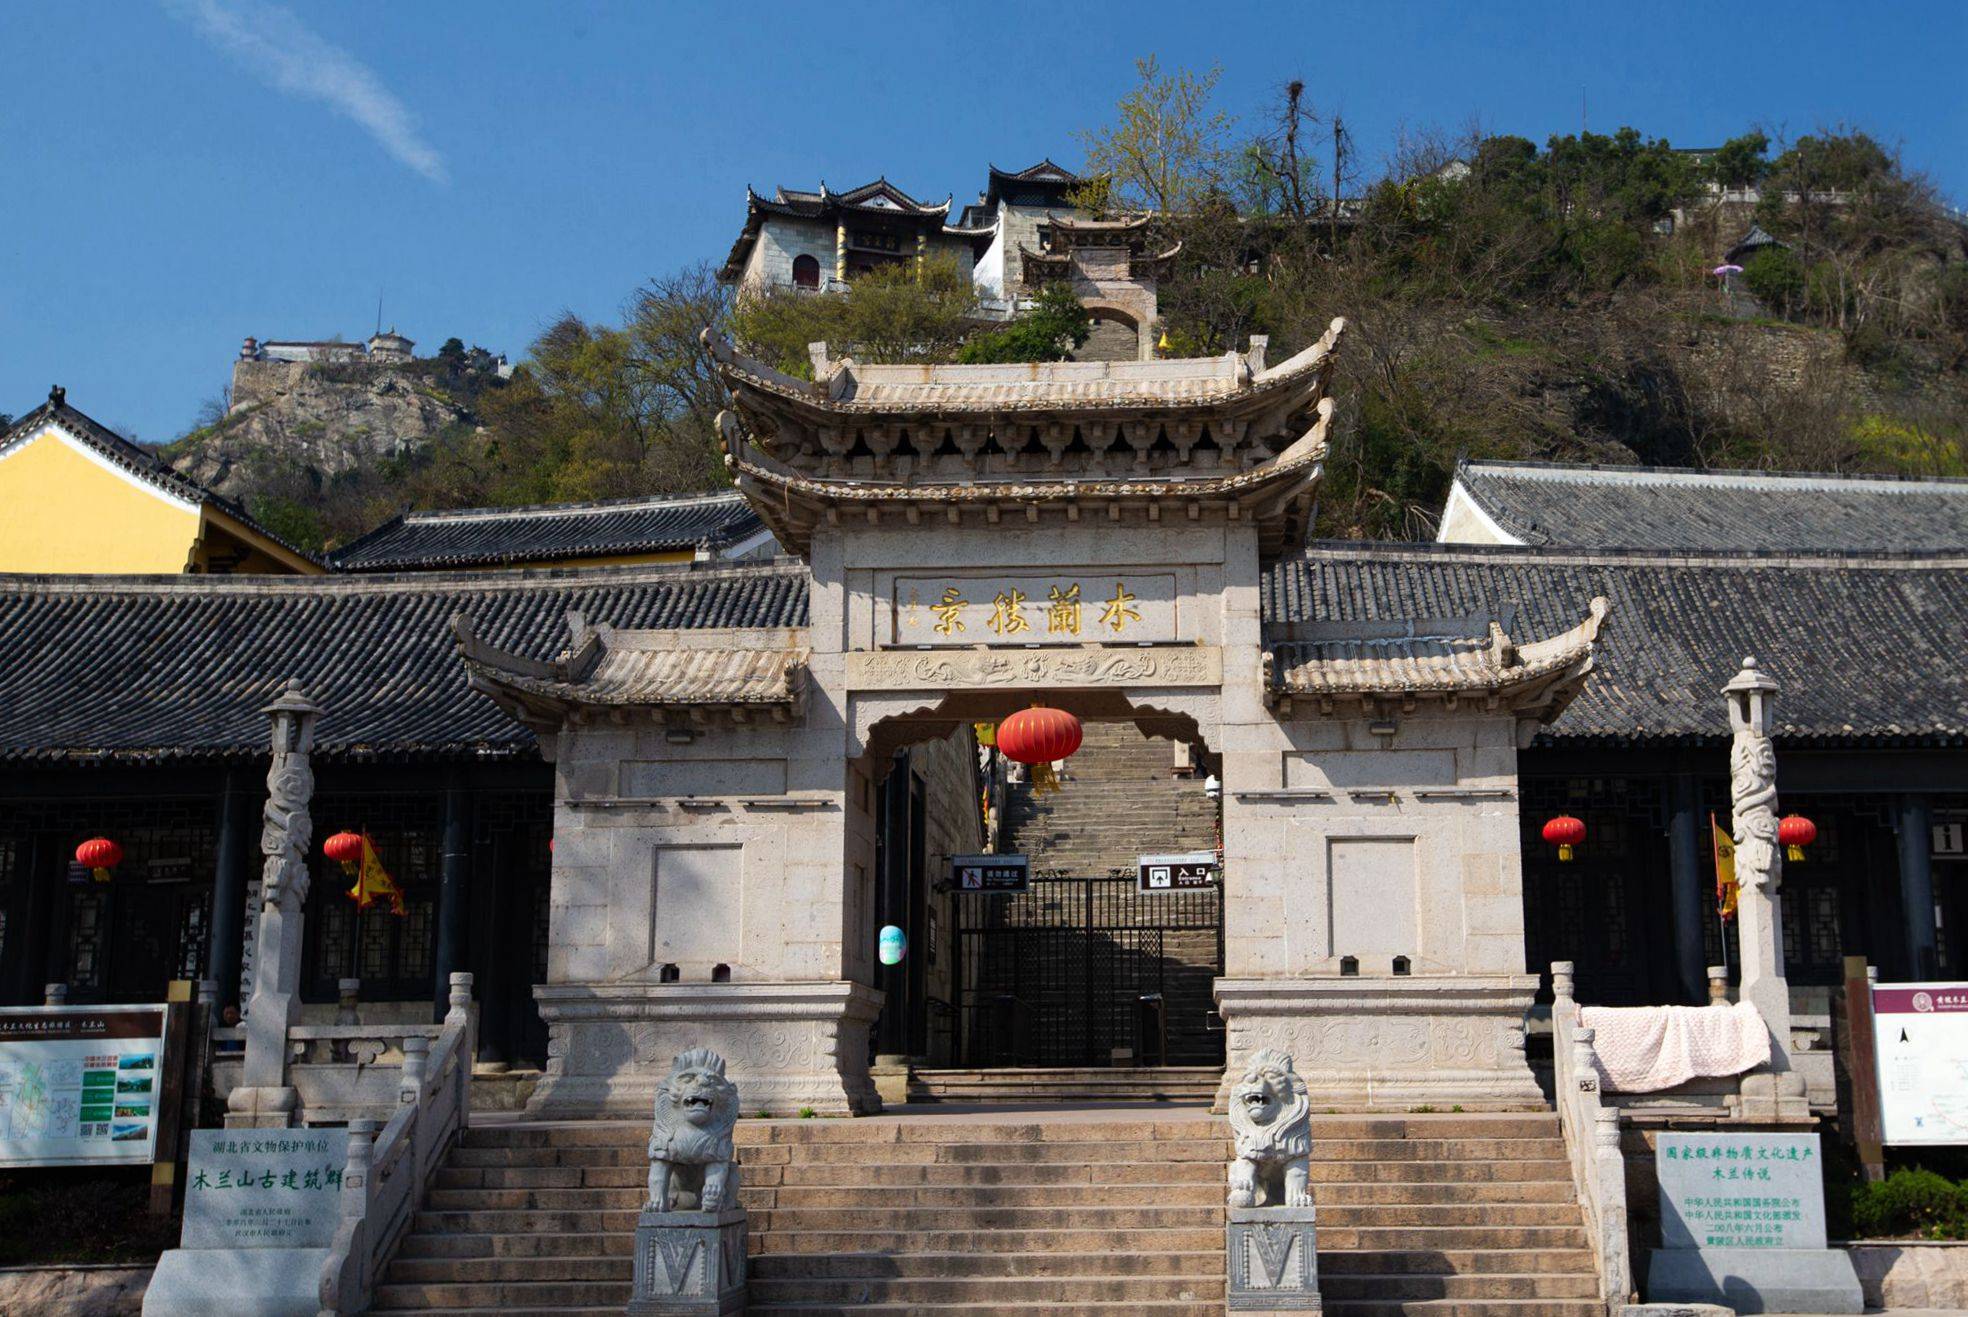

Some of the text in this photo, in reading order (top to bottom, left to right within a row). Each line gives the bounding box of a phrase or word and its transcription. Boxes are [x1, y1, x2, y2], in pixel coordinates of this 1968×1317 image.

[1179, 867, 1205, 876] 入口
[212, 1140, 329, 1154] 湖北省文物保护单位
[1666, 1146, 1814, 1161] 国家级非物质文化遗产
[192, 1168, 344, 1192] 木兰山古建筑群
[1712, 1166, 1771, 1181] 木兰传说
